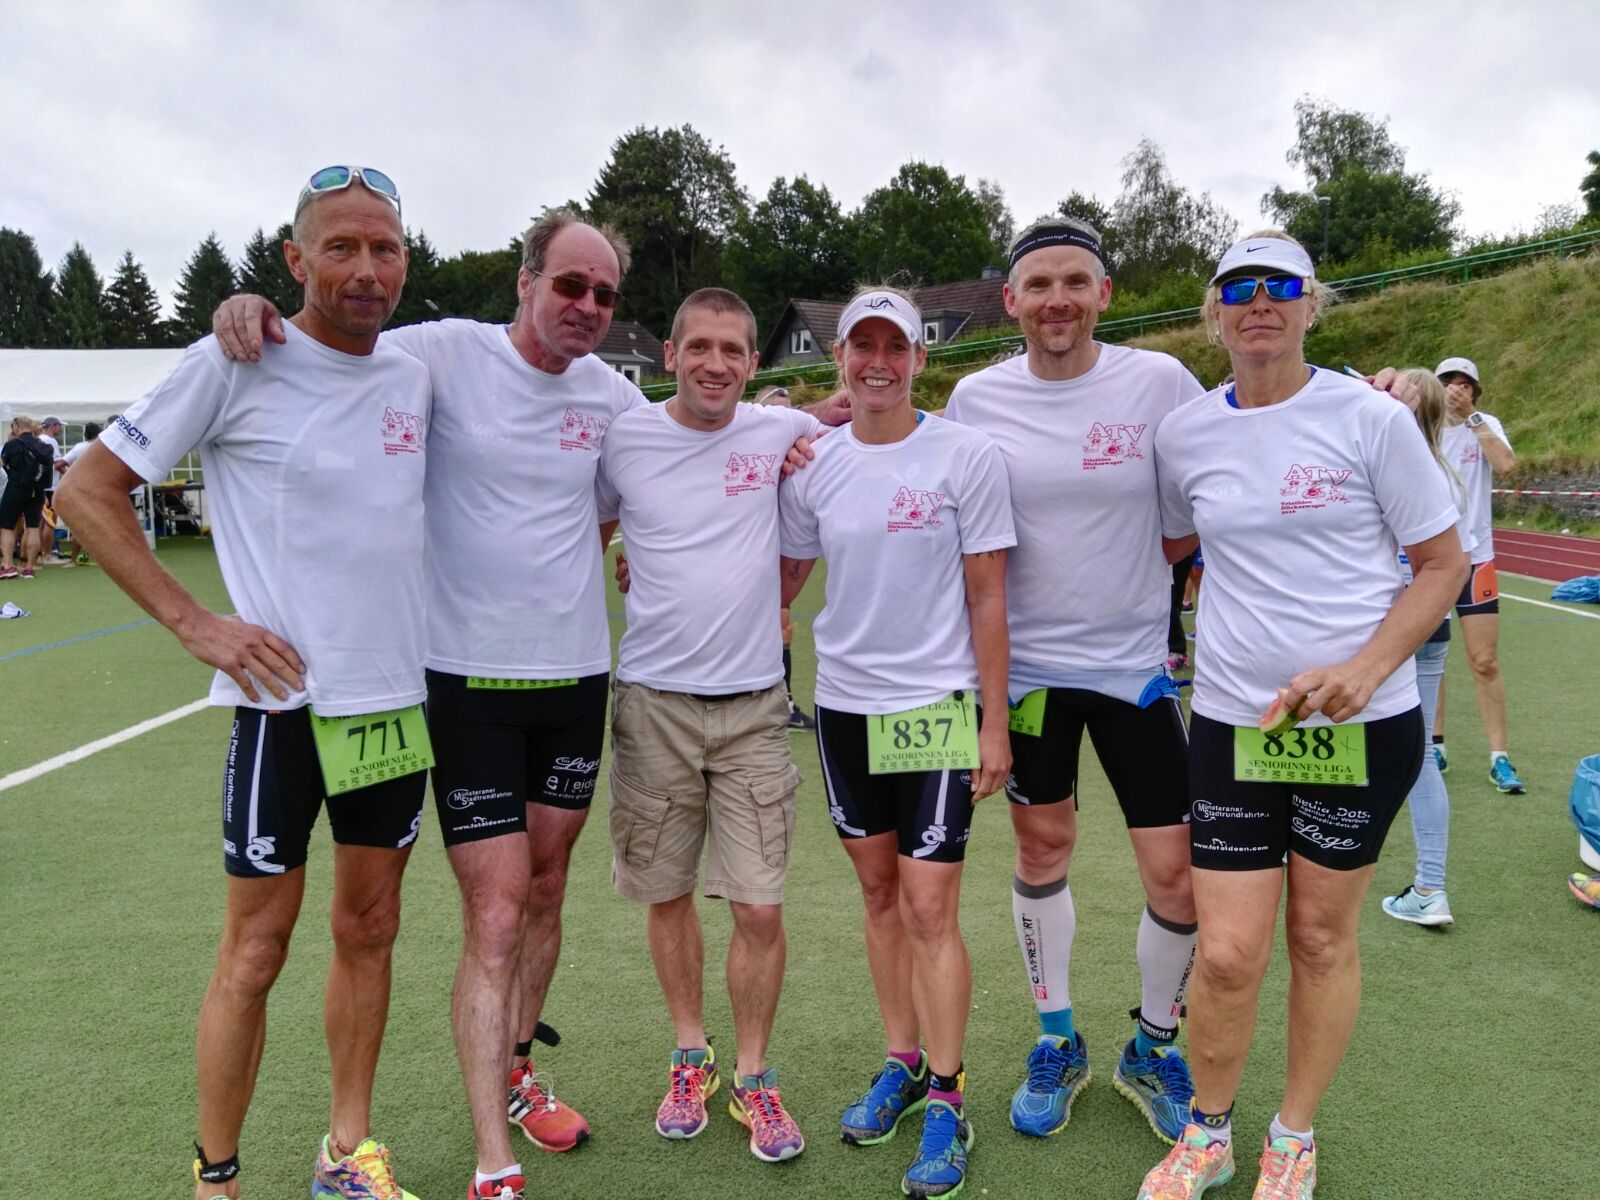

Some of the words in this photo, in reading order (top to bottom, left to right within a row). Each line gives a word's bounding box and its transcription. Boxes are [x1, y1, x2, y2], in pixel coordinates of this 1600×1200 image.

[1087, 422, 1147, 442] ATV
[726, 452, 777, 471] ATV
[1284, 464, 1352, 486] ATV
[892, 486, 945, 510] ATV
[347, 717, 409, 761] 771
[893, 718, 953, 749] 837
[1263, 726, 1335, 760] 838
[349, 752, 418, 776] SENIORENLIGA
[881, 751, 943, 761] SENIORINNEN
[945, 750, 968, 758] LIGA
[1248, 759, 1321, 772] SENIORINNEN
[1324, 763, 1353, 774] LIGA
[1291, 823, 1361, 850] Loge
